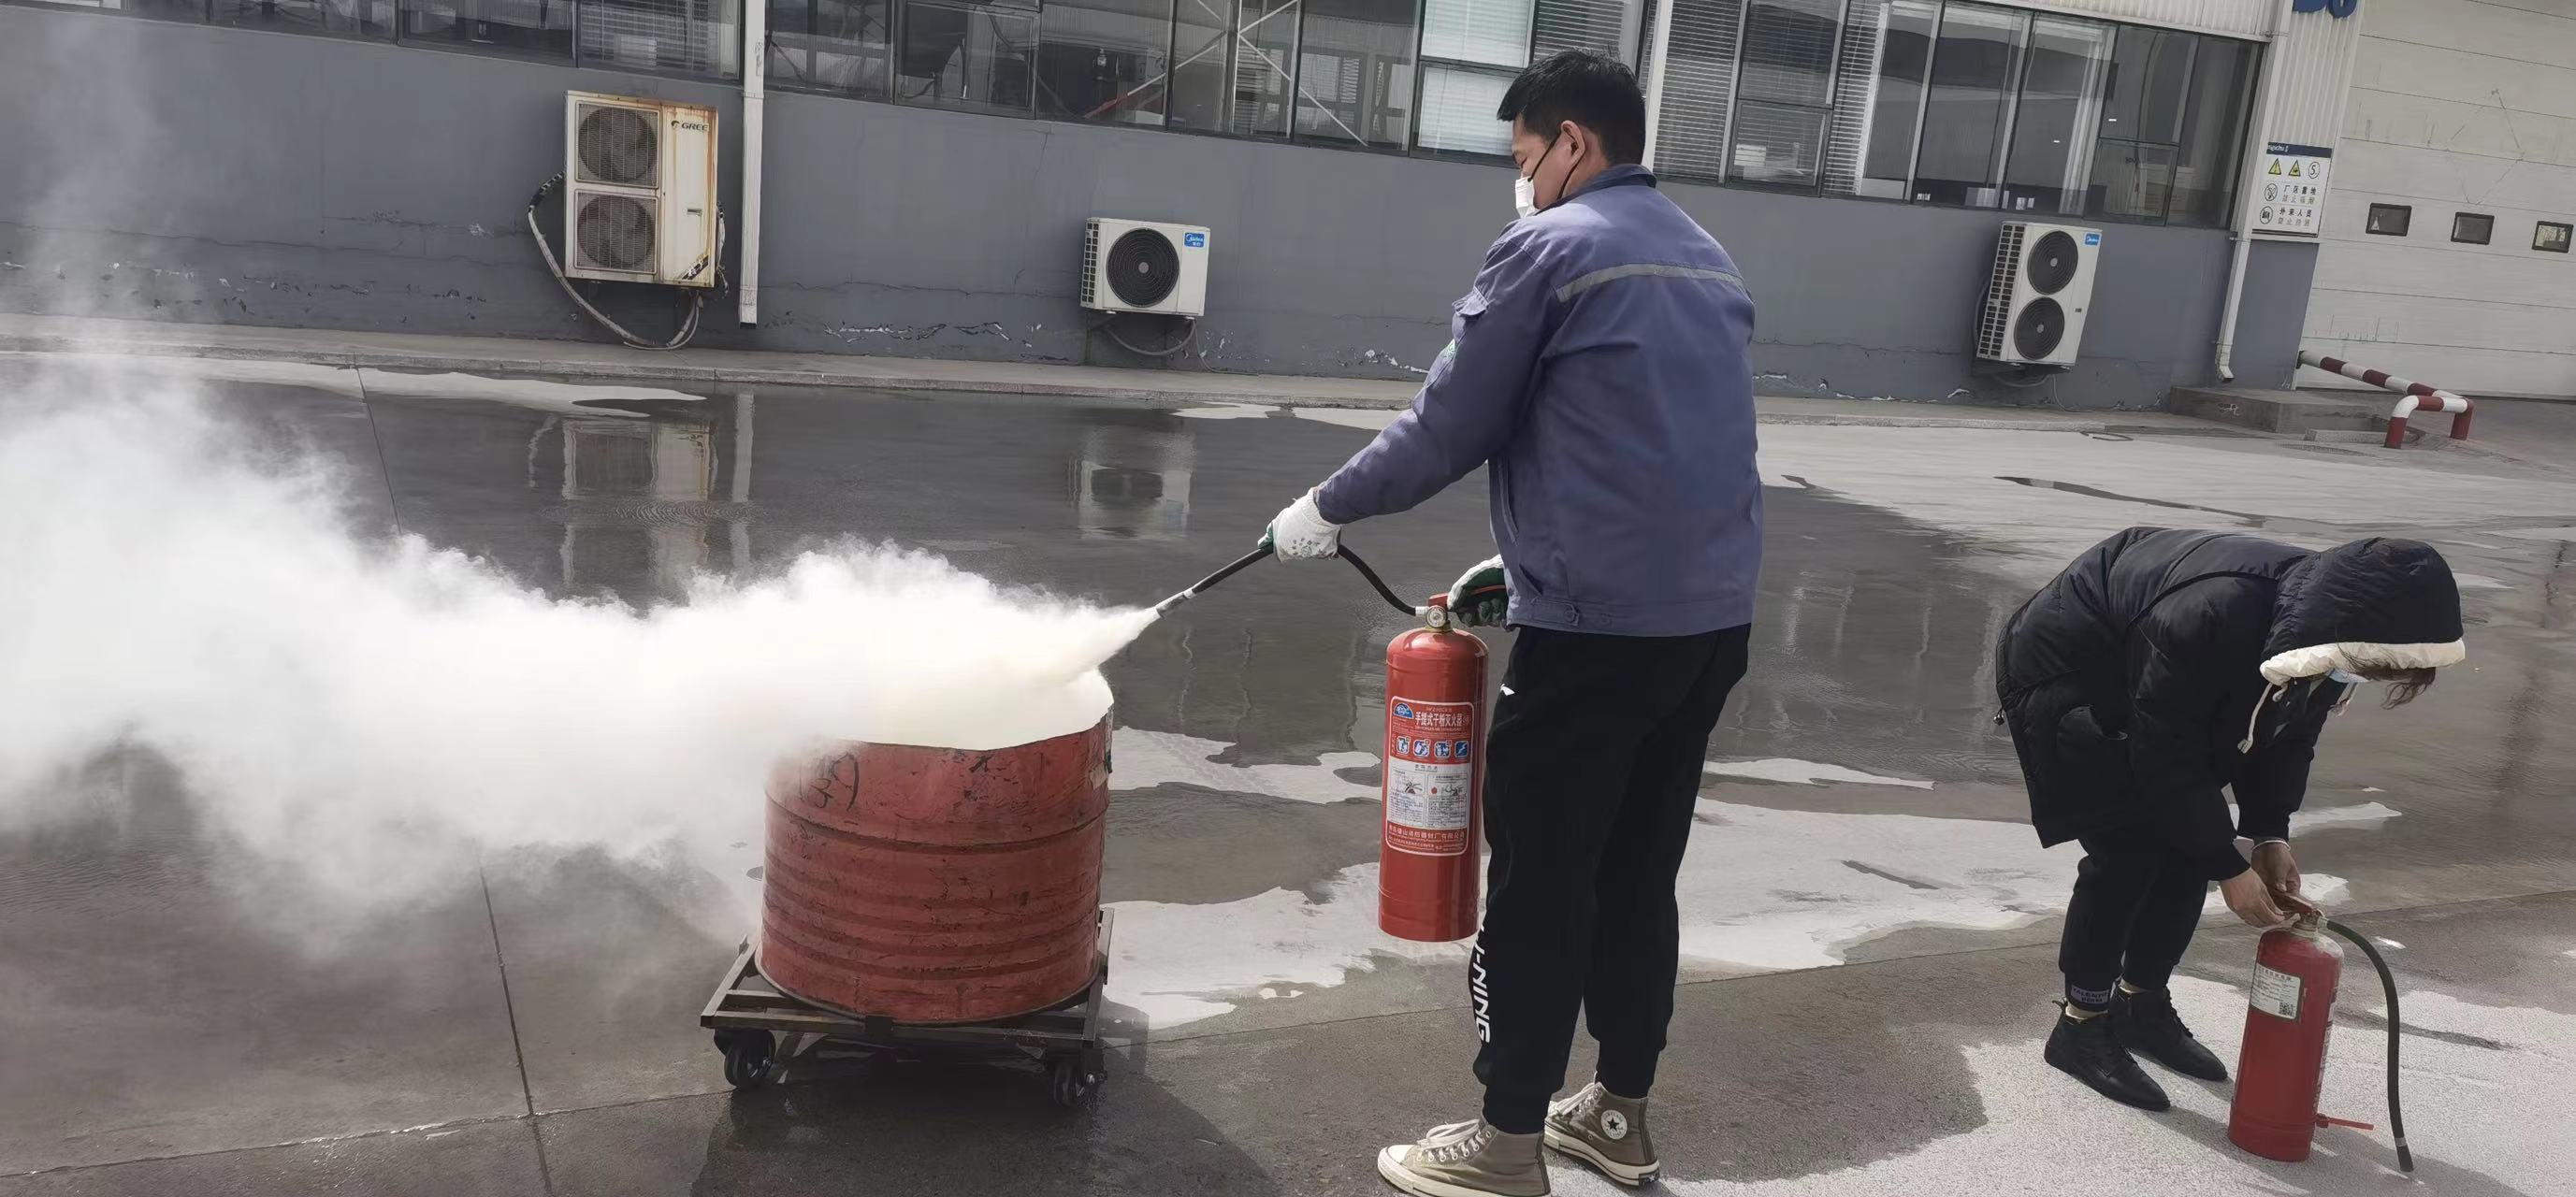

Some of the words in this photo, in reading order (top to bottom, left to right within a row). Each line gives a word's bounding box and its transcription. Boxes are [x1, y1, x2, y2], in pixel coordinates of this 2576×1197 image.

[681, 123, 709, 131] GREE
[2283, 184, 2317, 195] 厂区重地
[2279, 207, 2312, 217] 外来人员
[1415, 711, 1463, 728] 手提式干粉灭火器
[1472, 927, 1491, 1043] I-NING
